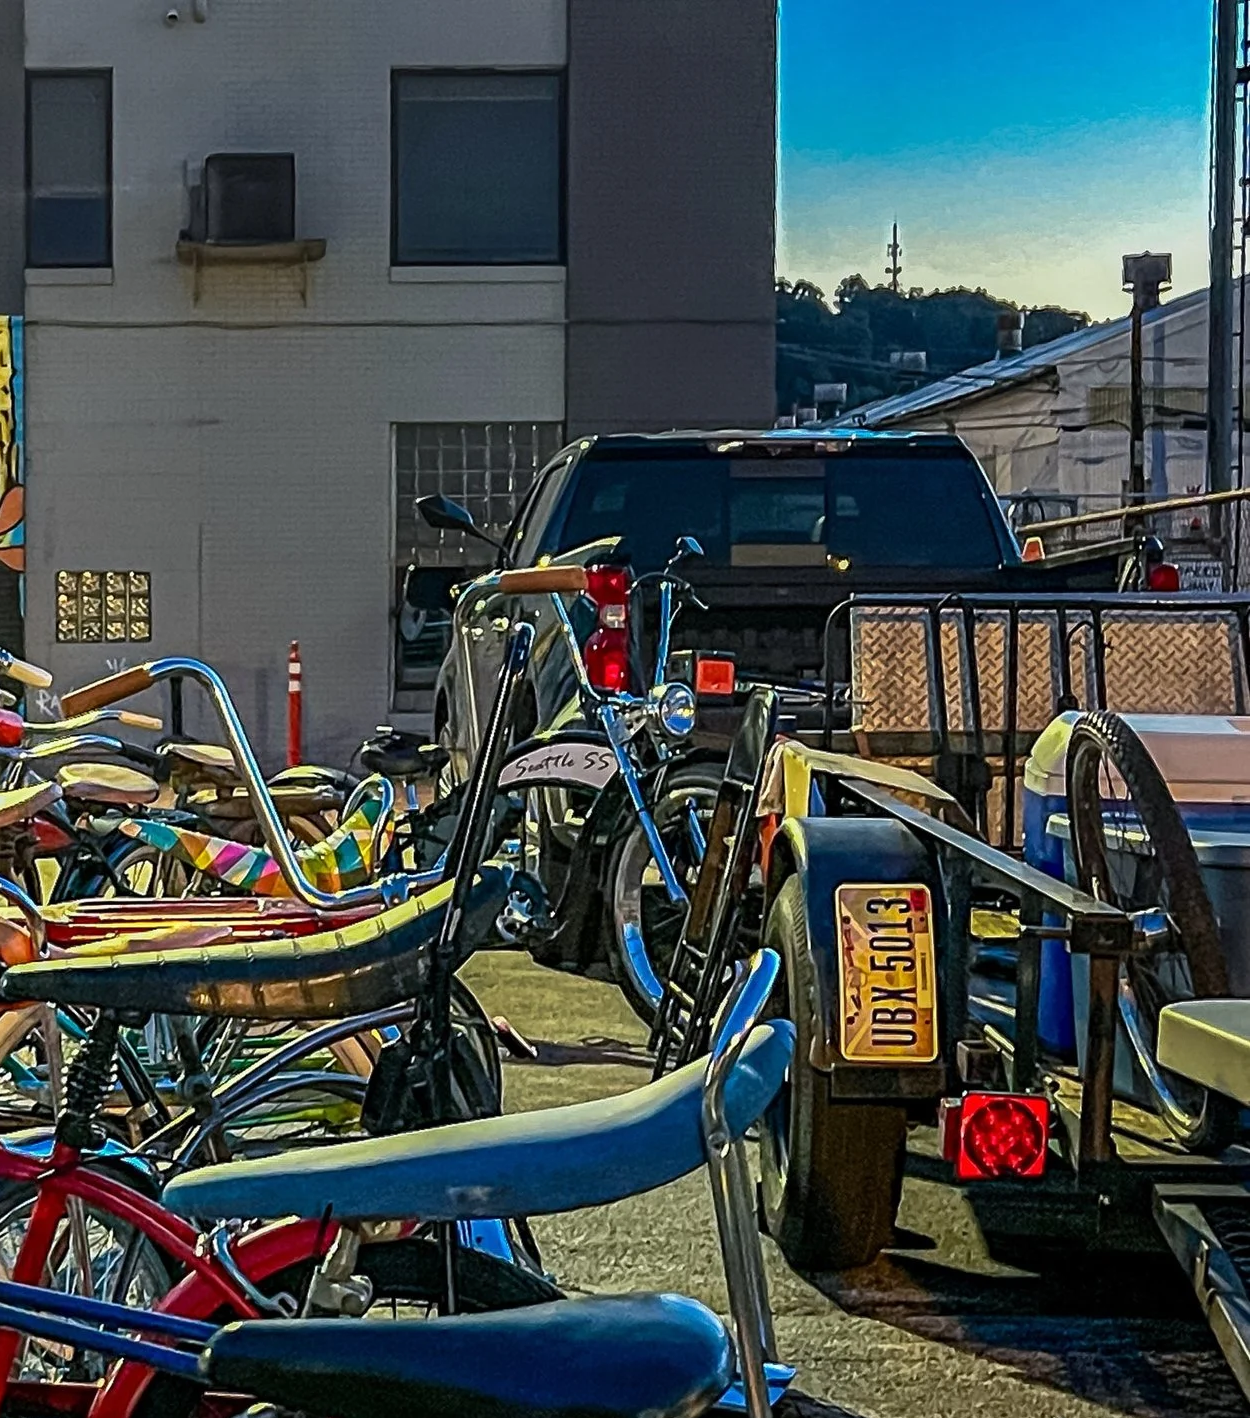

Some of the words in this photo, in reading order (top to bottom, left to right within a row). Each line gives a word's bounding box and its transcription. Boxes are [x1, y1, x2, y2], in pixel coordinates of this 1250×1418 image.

[515, 752, 574, 777] Seattle
[583, 752, 614, 771] SS
[866, 898, 915, 972] 5013
[871, 986, 918, 1047] UBX
